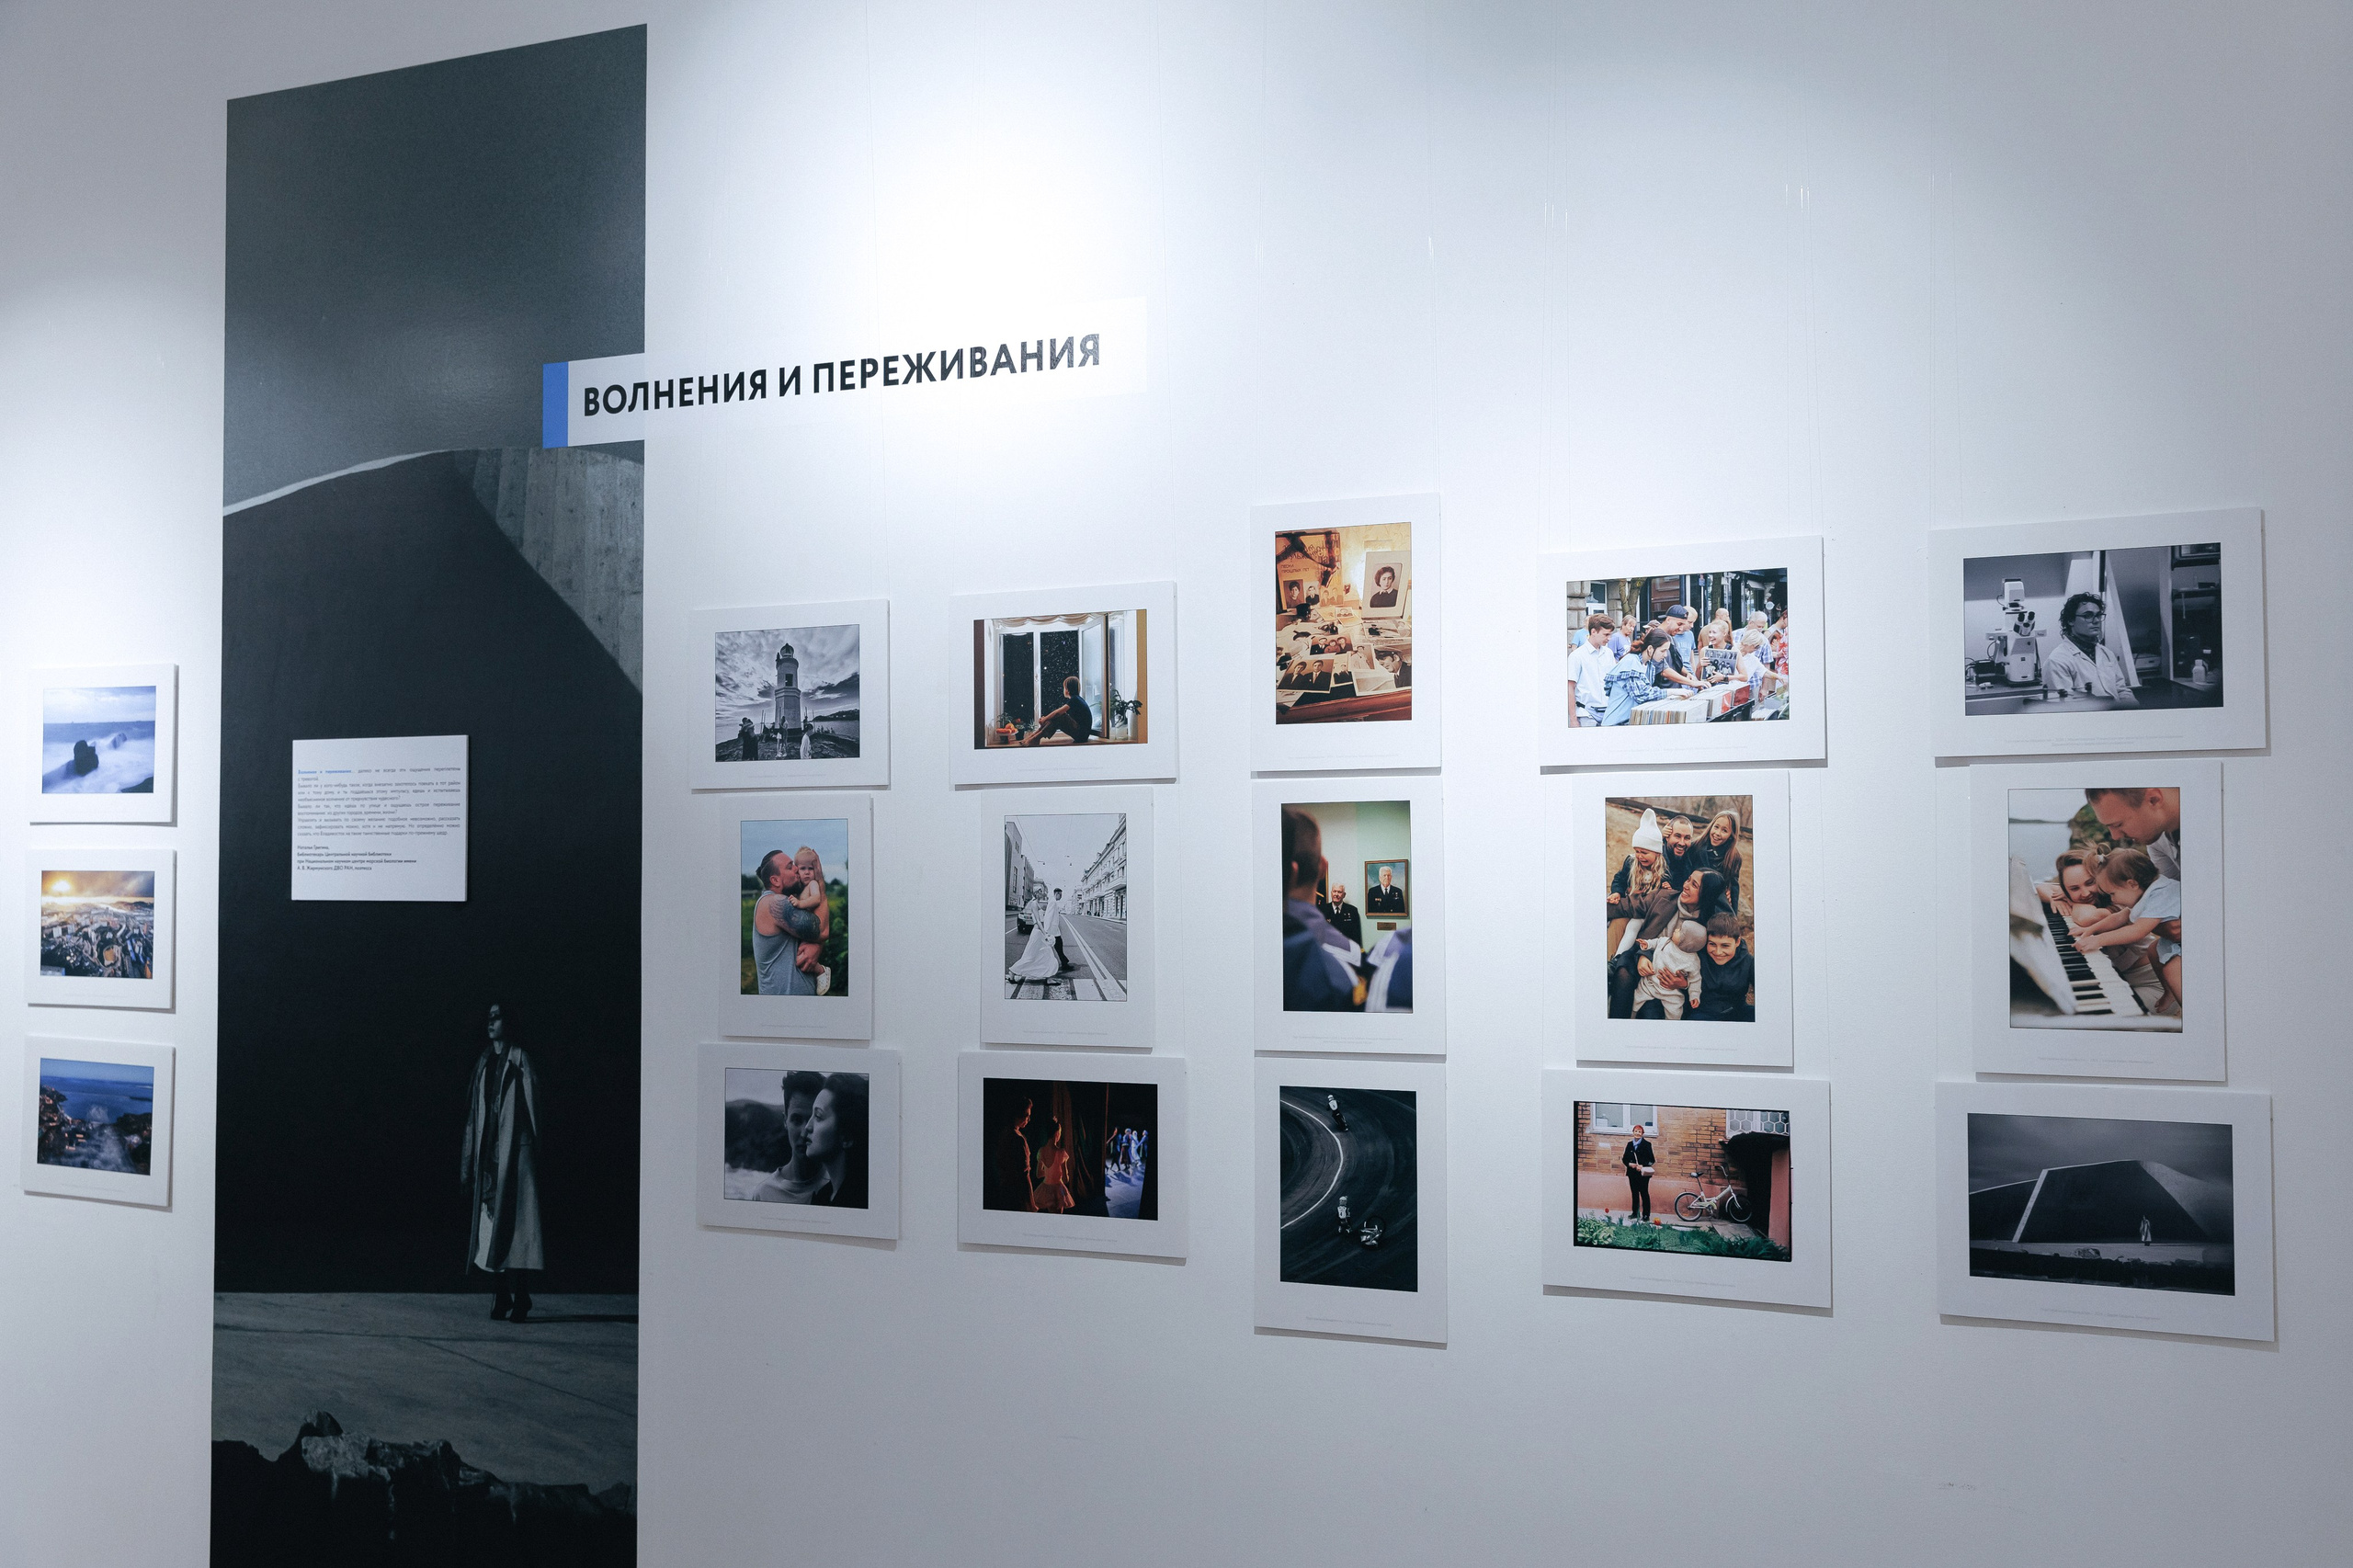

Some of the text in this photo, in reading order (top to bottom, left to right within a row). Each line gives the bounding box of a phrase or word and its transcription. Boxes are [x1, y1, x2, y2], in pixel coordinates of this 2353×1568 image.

[583, 333, 1101, 417] ВОЛНЕНИЯ И ПЕРЕЖИВАНИЯ
